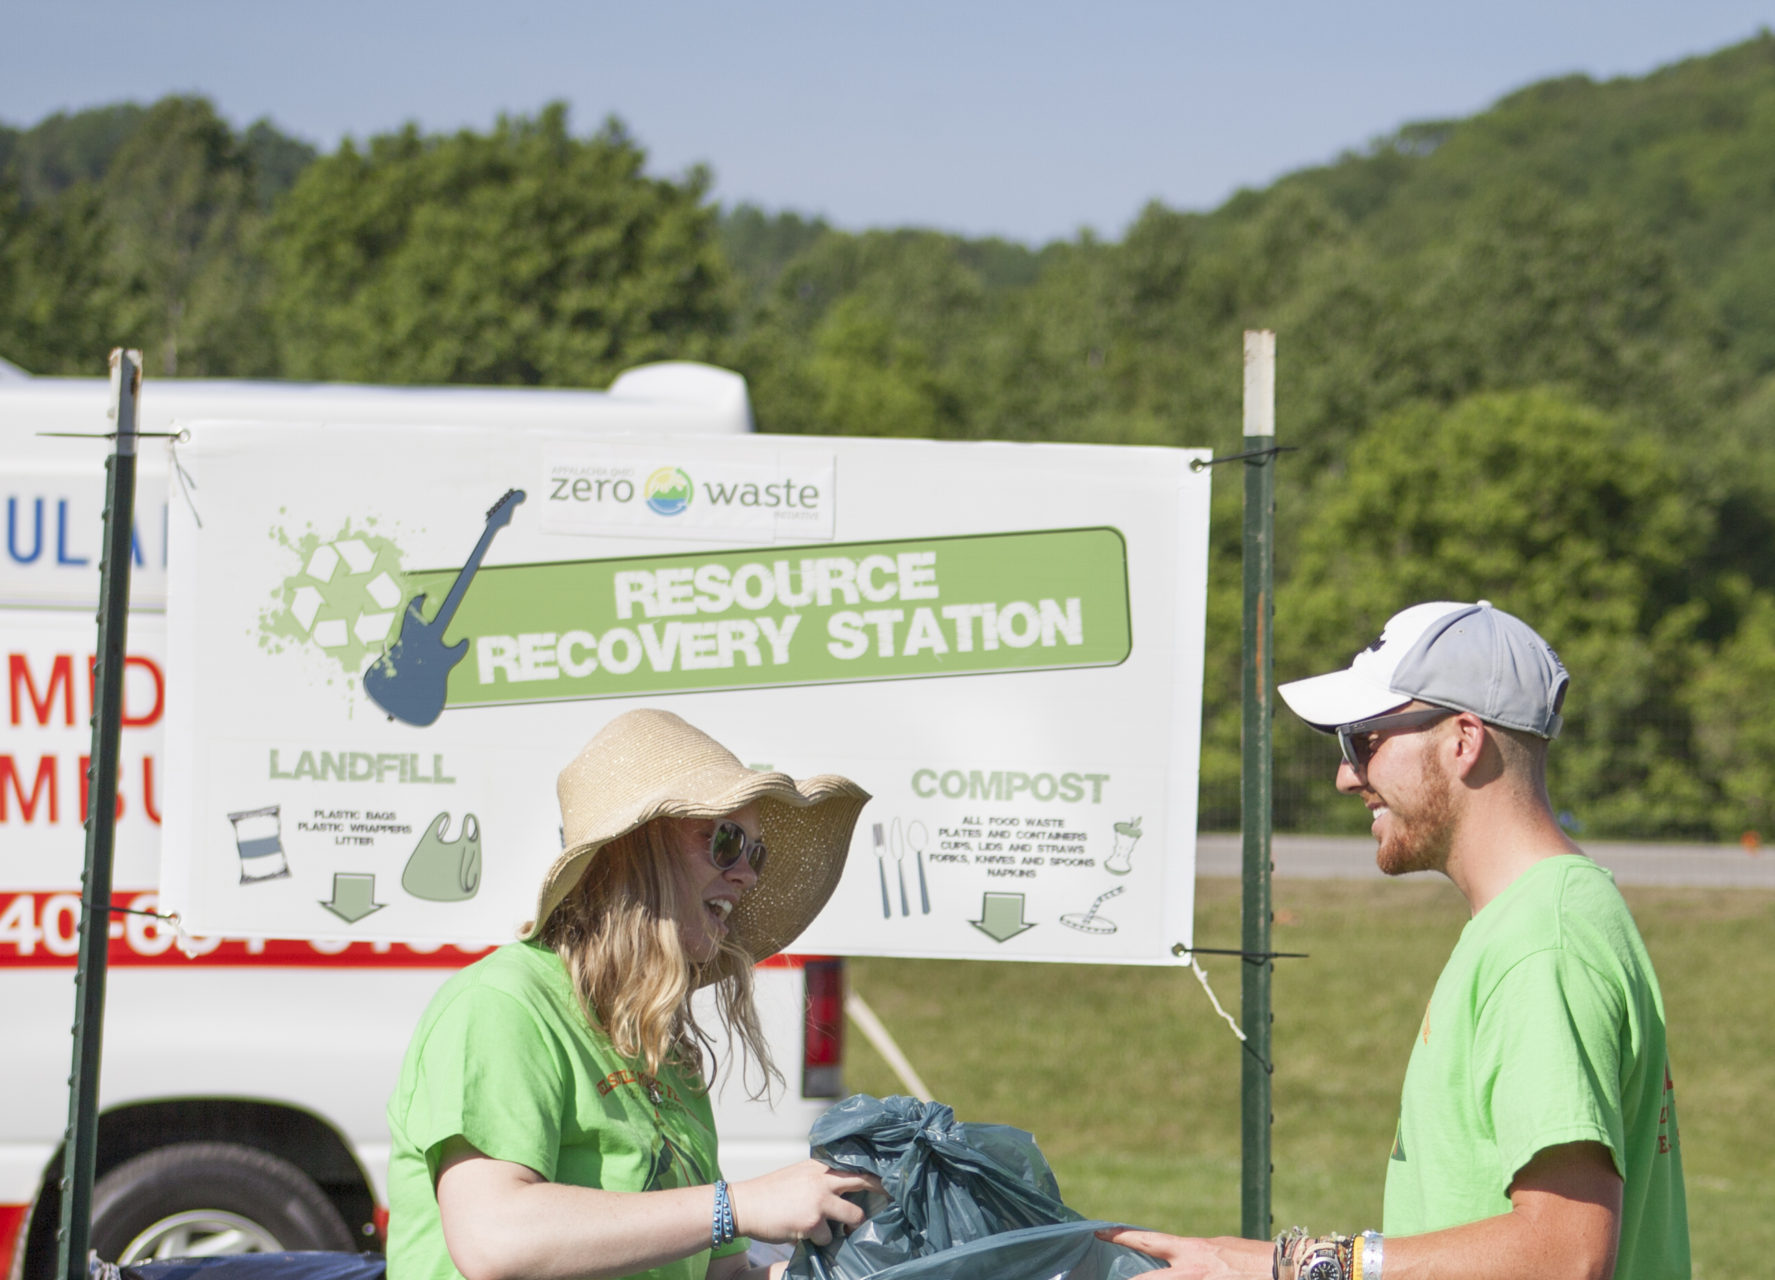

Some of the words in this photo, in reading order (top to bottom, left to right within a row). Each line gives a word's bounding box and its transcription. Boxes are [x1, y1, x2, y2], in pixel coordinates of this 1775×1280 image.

[549, 476, 635, 503] zero
[703, 478, 820, 508] waste
[614, 551, 939, 620] RESOURCE
[476, 614, 802, 684] RECOVERY
[826, 597, 1083, 660] STATION
[269, 748, 456, 784] LANDFILL
[911, 768, 1110, 804] COMPOST
[314, 810, 360, 820] PLASTIC
[366, 811, 396, 821] BAGS
[962, 816, 983, 825] ALL
[989, 817, 1019, 826] FOOD
[1025, 818, 1064, 828] WASTE
[298, 822, 344, 832] PLASTIC
[350, 823, 412, 834] WRAPPERS
[938, 828, 982, 838] PLATES
[988, 829, 1011, 839] AND
[1016, 830, 1087, 841] CONTAINERS
[335, 836, 374, 846] LITTER
[940, 841, 973, 851] CUPS,
[978, 841, 1003, 851] LIDS
[1009, 843, 1032, 852] AND
[1038, 844, 1085, 854] STRAWS
[929, 854, 970, 864] FORKS,
[975, 855, 1015, 865] KNIVES
[1021, 856, 1044, 866] AND
[1050, 856, 1095, 867] SPOONS
[987, 868, 1036, 878] NAPKINS
